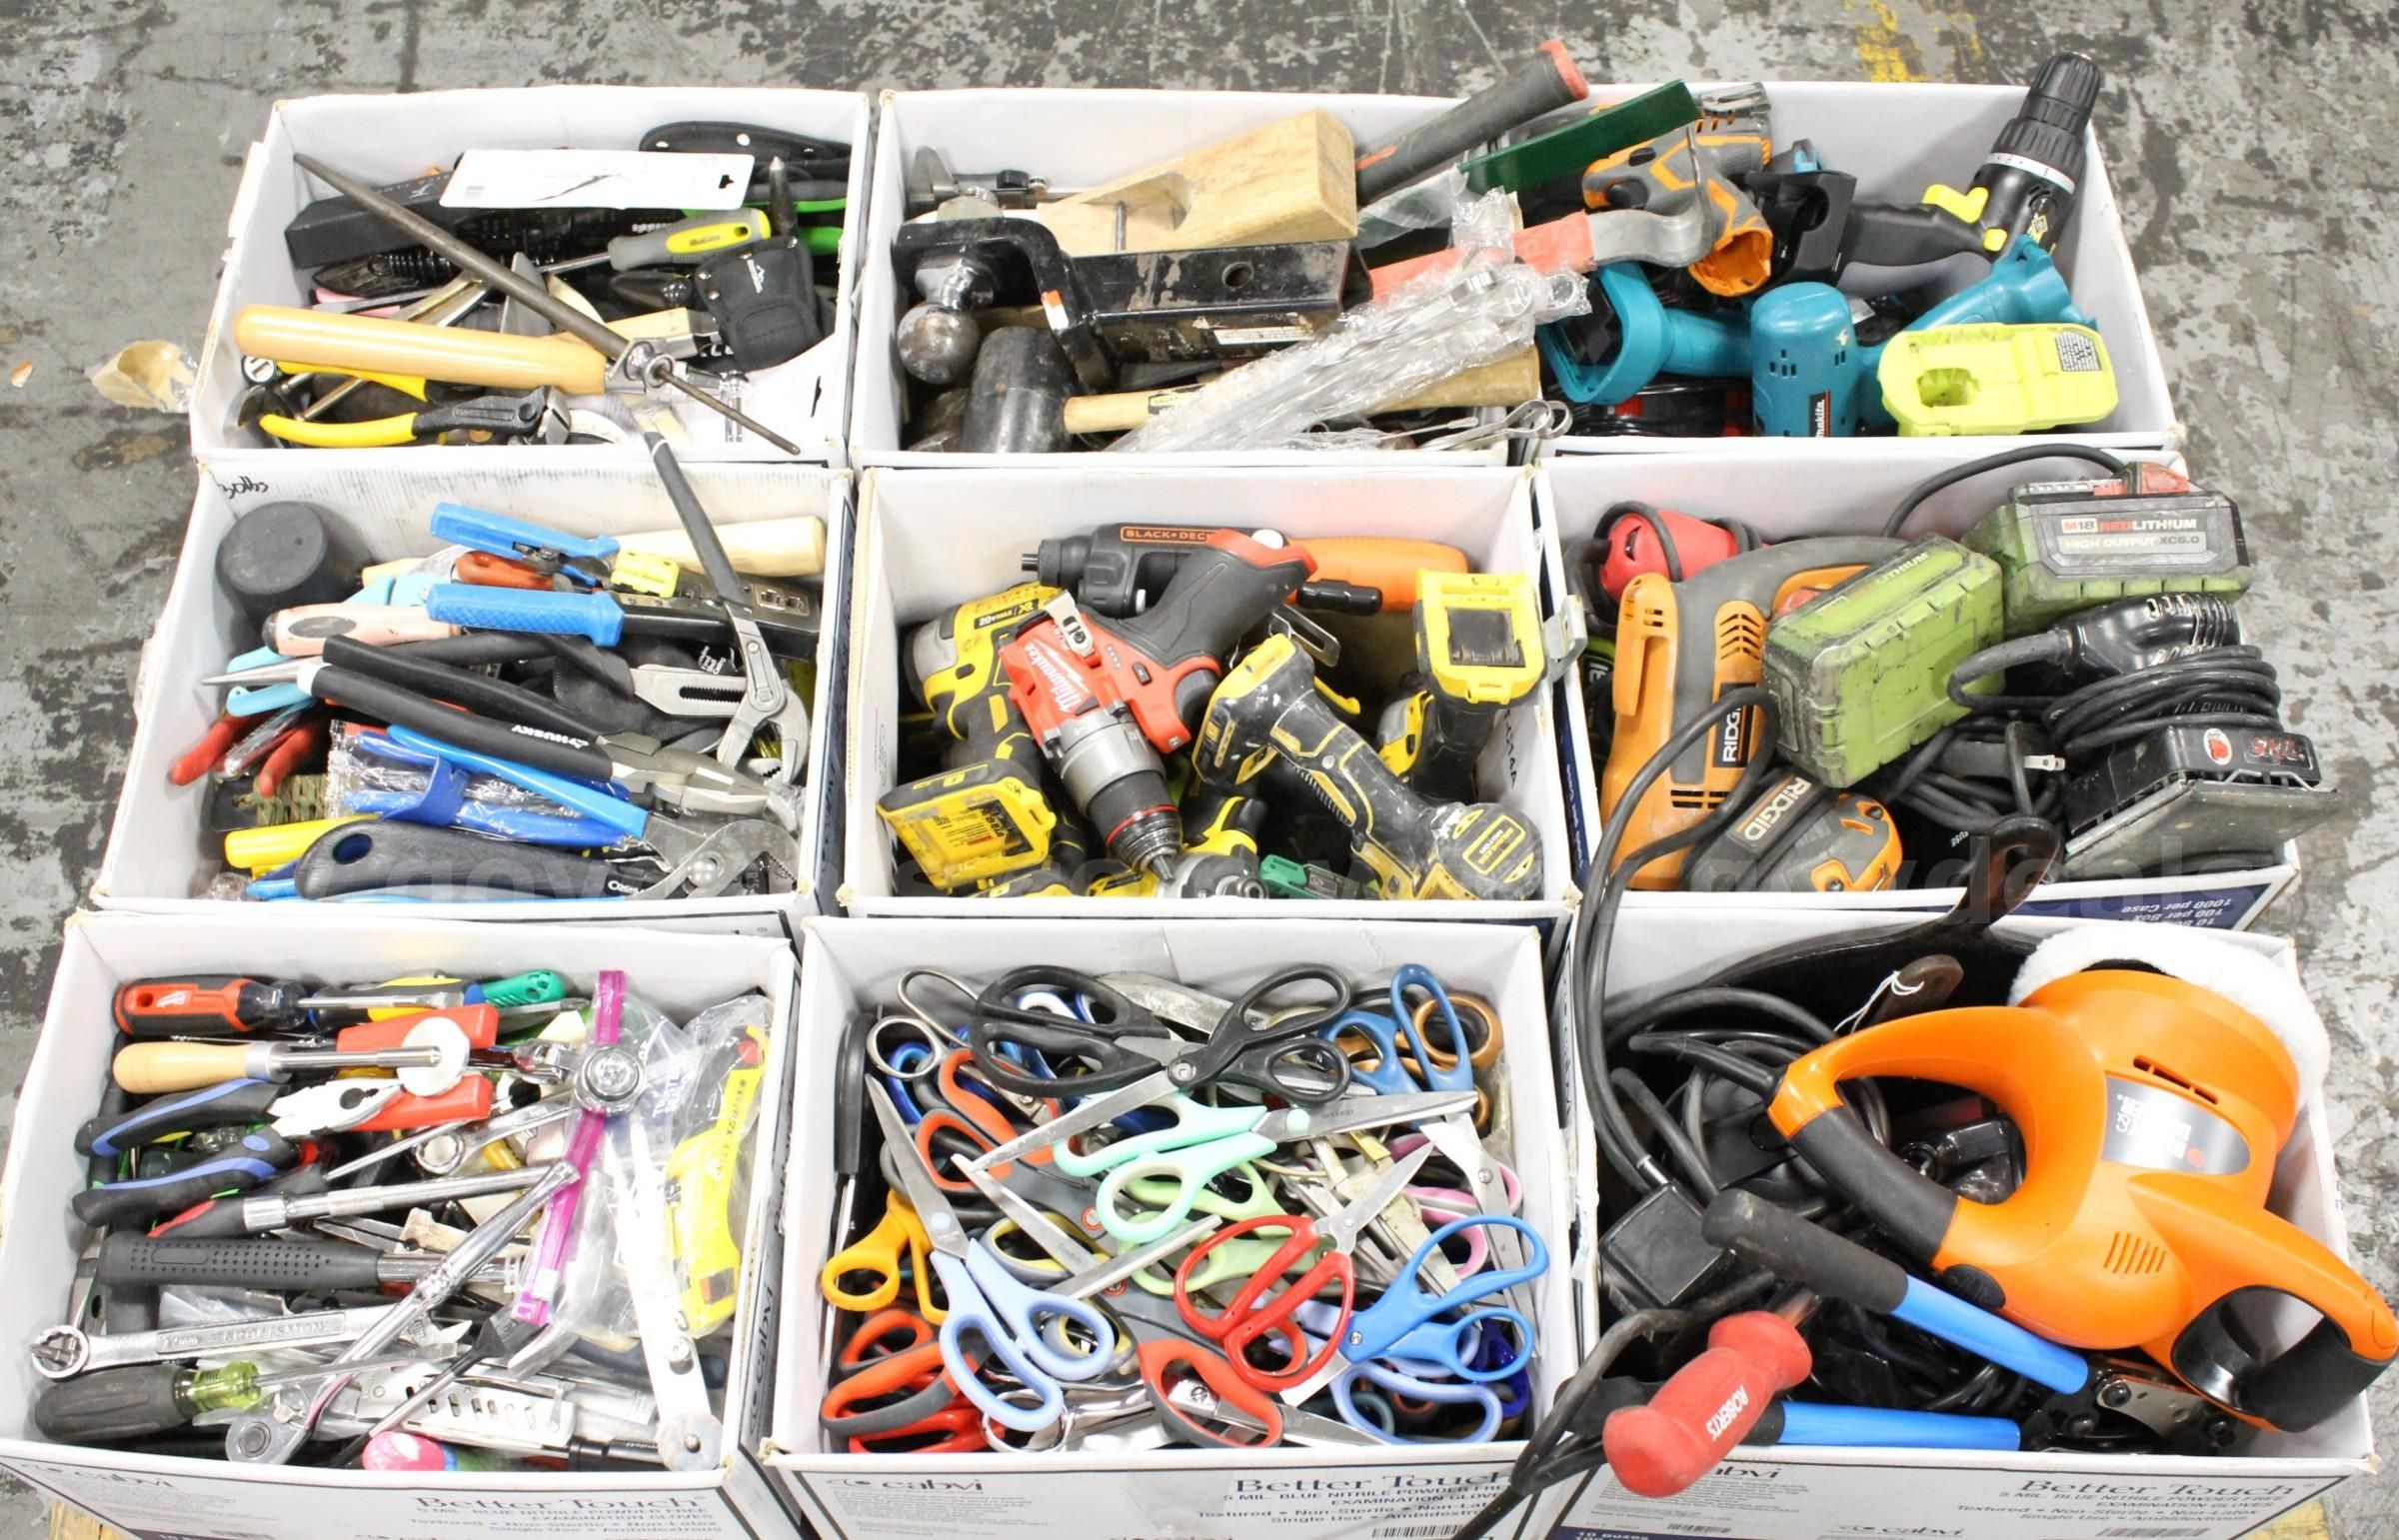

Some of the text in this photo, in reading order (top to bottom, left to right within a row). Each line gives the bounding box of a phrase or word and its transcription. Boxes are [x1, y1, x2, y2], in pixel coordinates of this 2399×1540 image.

[2062, 519, 2096, 532] M18
[1126, 529, 1211, 541] BLACK+DEC
[2102, 536, 2157, 549] OUTPUT
[1023, 640, 1084, 714] Milwaukee
[510, 723, 570, 746] HUSKY
[1721, 708, 1742, 764] RIDG
[1743, 775, 1814, 841] RIDGID
[2120, 897, 2232, 914] 1000 per Case
[2195, 907, 2224, 917] 100
[2165, 908, 2194, 919] per
[1708, 1383, 1749, 1443] ROBERTS
[882, 1478, 983, 1491] cabvi
[1235, 1479, 1372, 1492] Better
[2019, 1480, 2295, 1496] Better Touch
[416, 1497, 700, 1509] Better Touch
[1330, 1495, 1443, 1506] EXAMINATION
